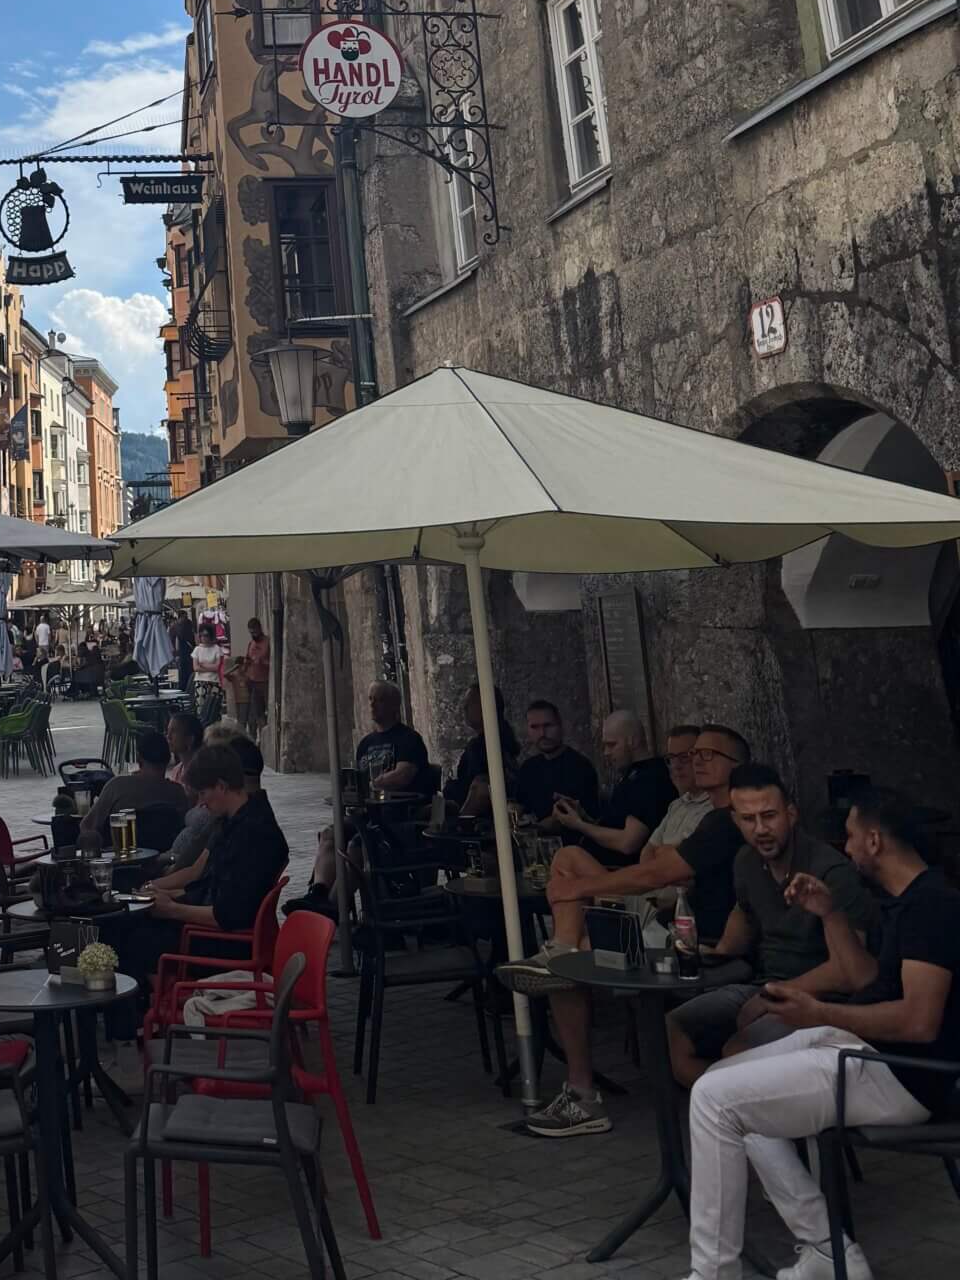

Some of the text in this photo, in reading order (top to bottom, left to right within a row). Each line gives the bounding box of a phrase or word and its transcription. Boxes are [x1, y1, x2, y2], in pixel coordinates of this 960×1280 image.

[313, 57, 395, 87] HANDL
[319, 80, 384, 113] Tyrol
[129, 180, 198, 195] Weinhaus
[12, 260, 66, 279] Happ
[759, 303, 778, 338] 12
